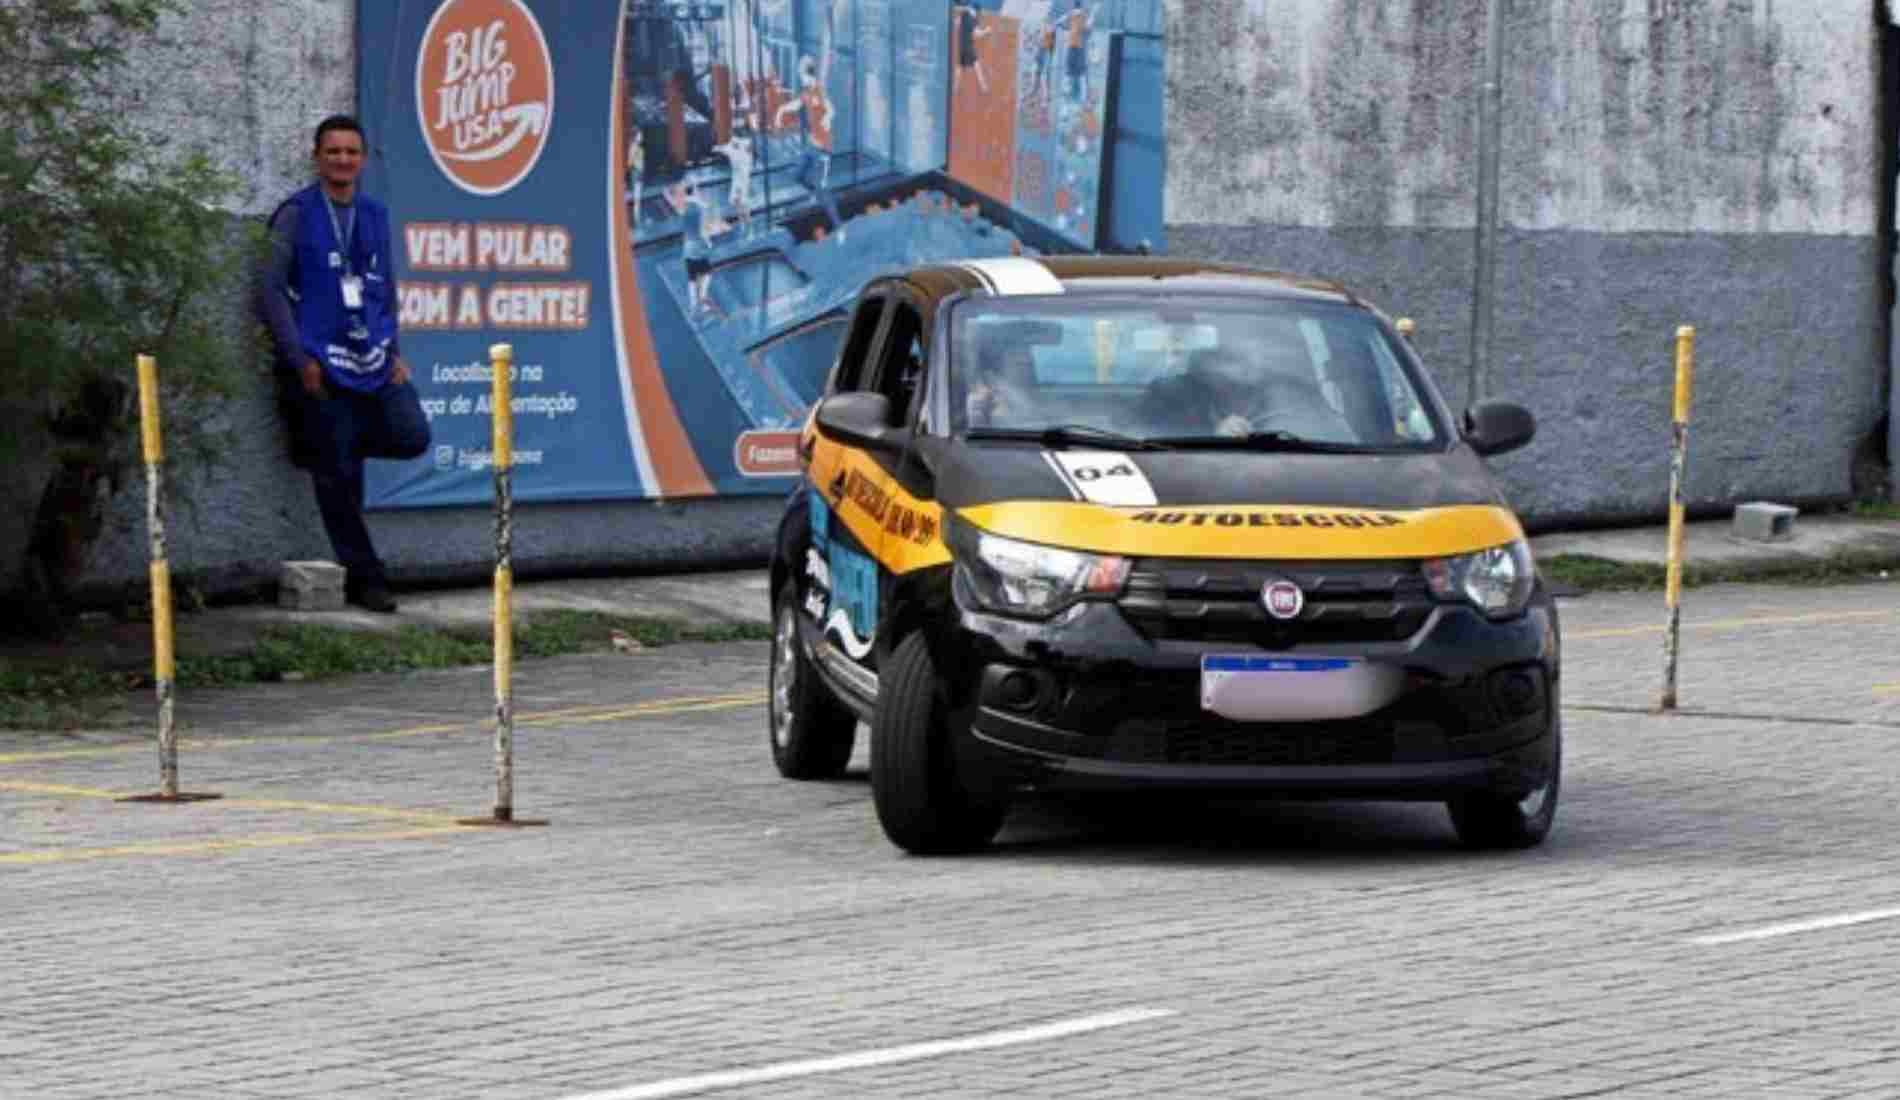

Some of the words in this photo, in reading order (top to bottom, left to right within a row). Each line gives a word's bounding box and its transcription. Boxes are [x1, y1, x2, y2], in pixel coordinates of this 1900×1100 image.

[444, 20, 506, 84] BIG
[434, 61, 516, 129] JUMP
[453, 109, 504, 151] USA
[406, 226, 469, 266] VEM
[476, 226, 570, 267] PULAR
[457, 285, 481, 324] A
[488, 284, 590, 326] GENTE!
[520, 365, 544, 382] na
[450, 393, 472, 415] de
[1073, 463, 1134, 482] 04
[1130, 510, 1406, 528] AUTOESCOLA
